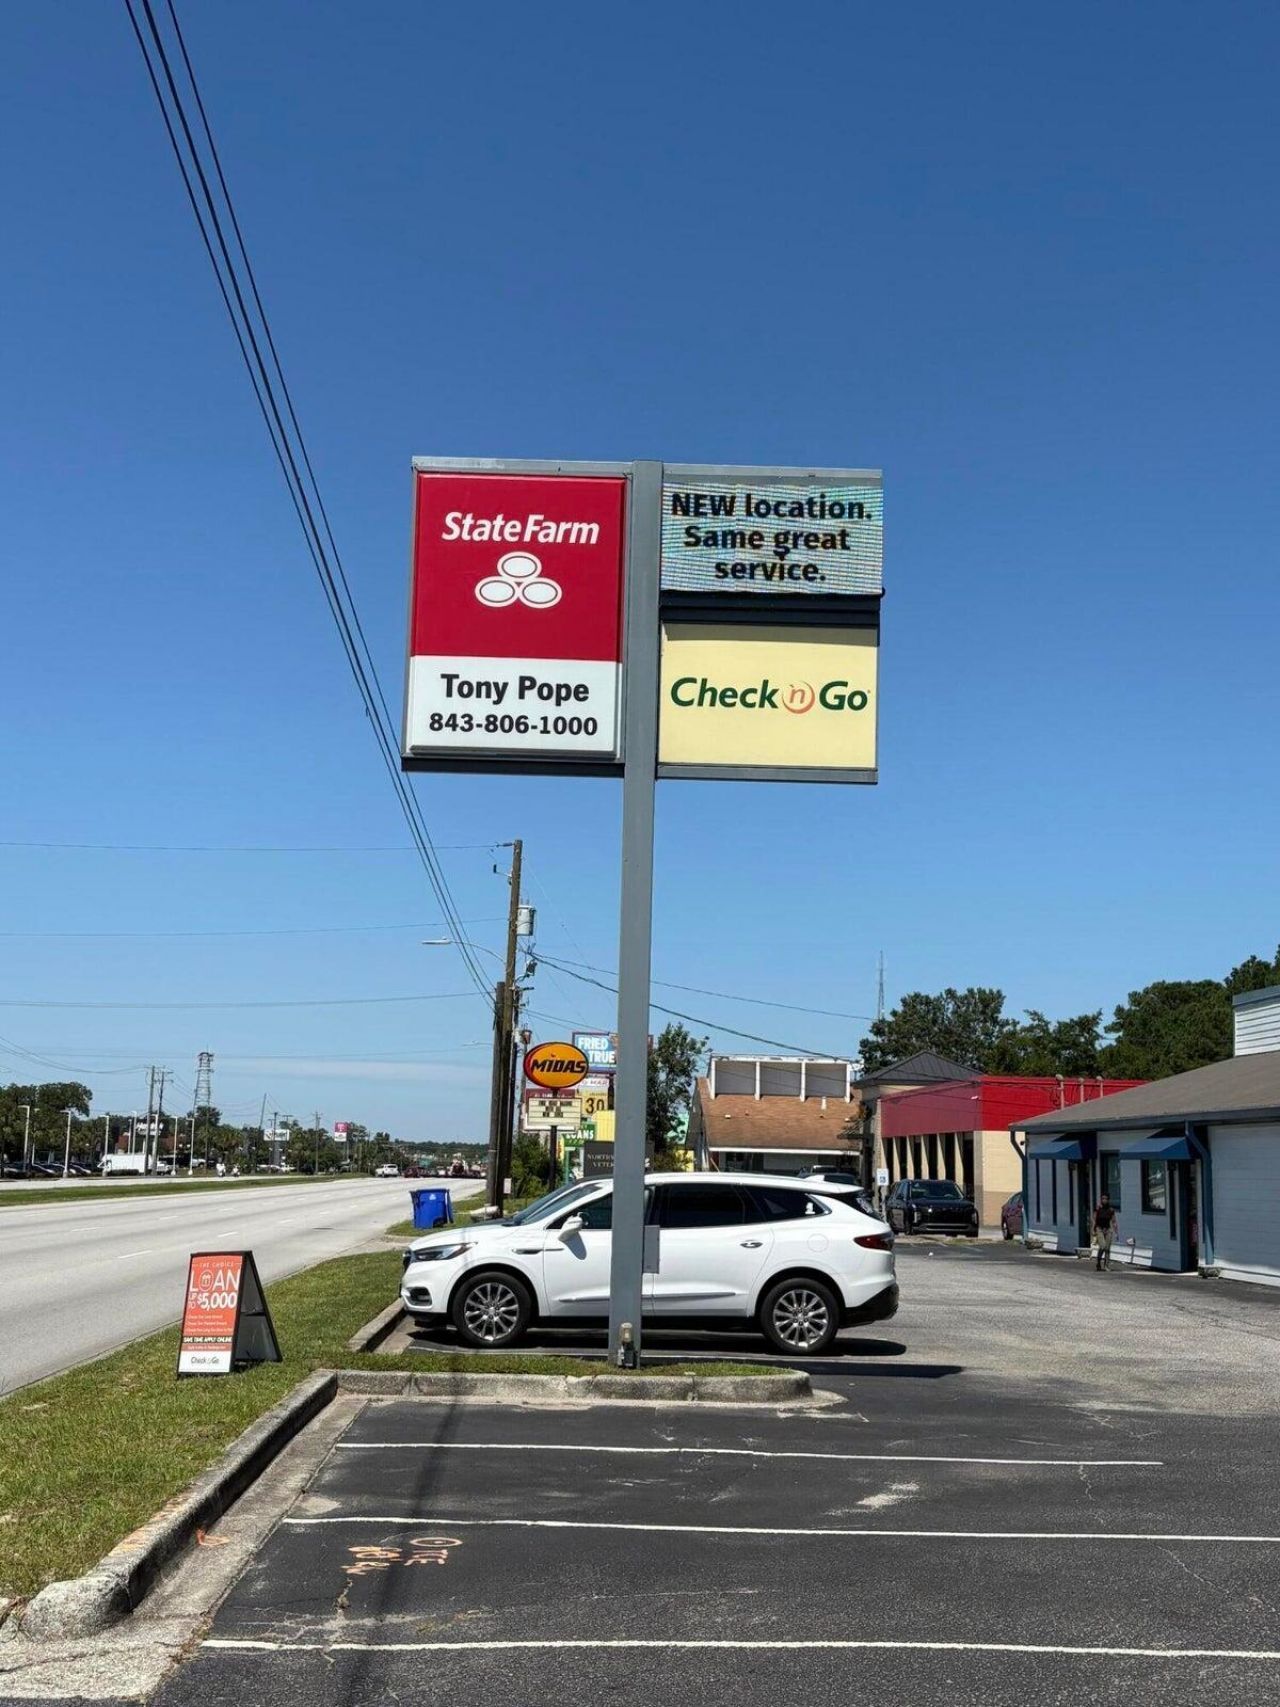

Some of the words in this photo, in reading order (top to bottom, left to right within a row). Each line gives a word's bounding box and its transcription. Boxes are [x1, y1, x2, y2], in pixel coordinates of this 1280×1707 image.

[671, 493, 736, 517] NEW
[745, 493, 873, 519] location.
[683, 525, 765, 549] Same
[772, 528, 851, 556] great
[714, 558, 826, 582] service.
[440, 674, 509, 705] Tony
[518, 675, 590, 707] Pope
[670, 676, 780, 709] Check
[818, 680, 868, 711] Go
[429, 713, 598, 736] 843-806-1000
[578, 1037, 608, 1049] FRIED
[532, 1059, 586, 1073] MIDAS
[588, 1050, 616, 1063] TRUE
[197, 1292, 237, 1311] $5,000
